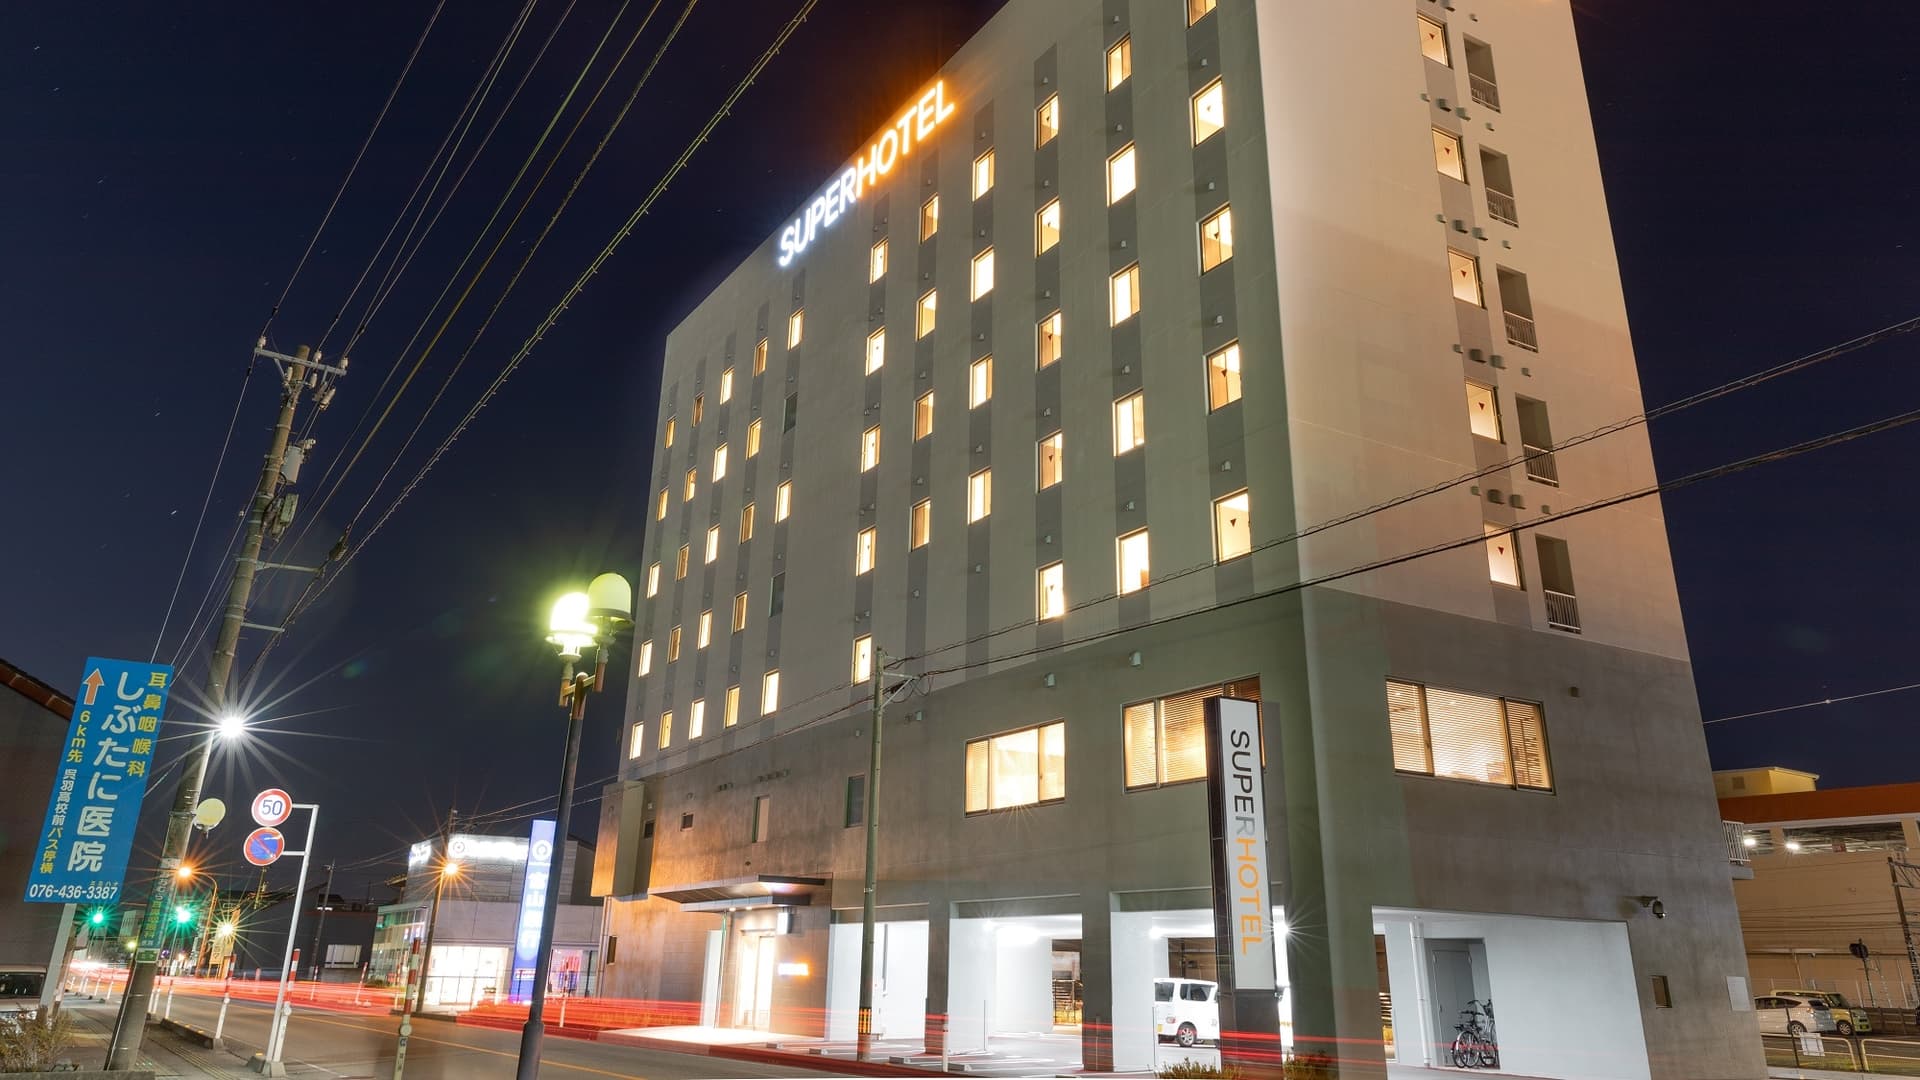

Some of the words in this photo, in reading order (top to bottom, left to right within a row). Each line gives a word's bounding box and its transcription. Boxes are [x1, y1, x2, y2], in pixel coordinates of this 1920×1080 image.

[67, 671, 145, 873] しぶたに医院
[127, 672, 168, 777] 耳鼻咽喉科
[40, 768, 77, 874] 呉羽高校前バス停横
[262, 799, 283, 816] 50
[29, 884, 118, 900] 076-436-3387
